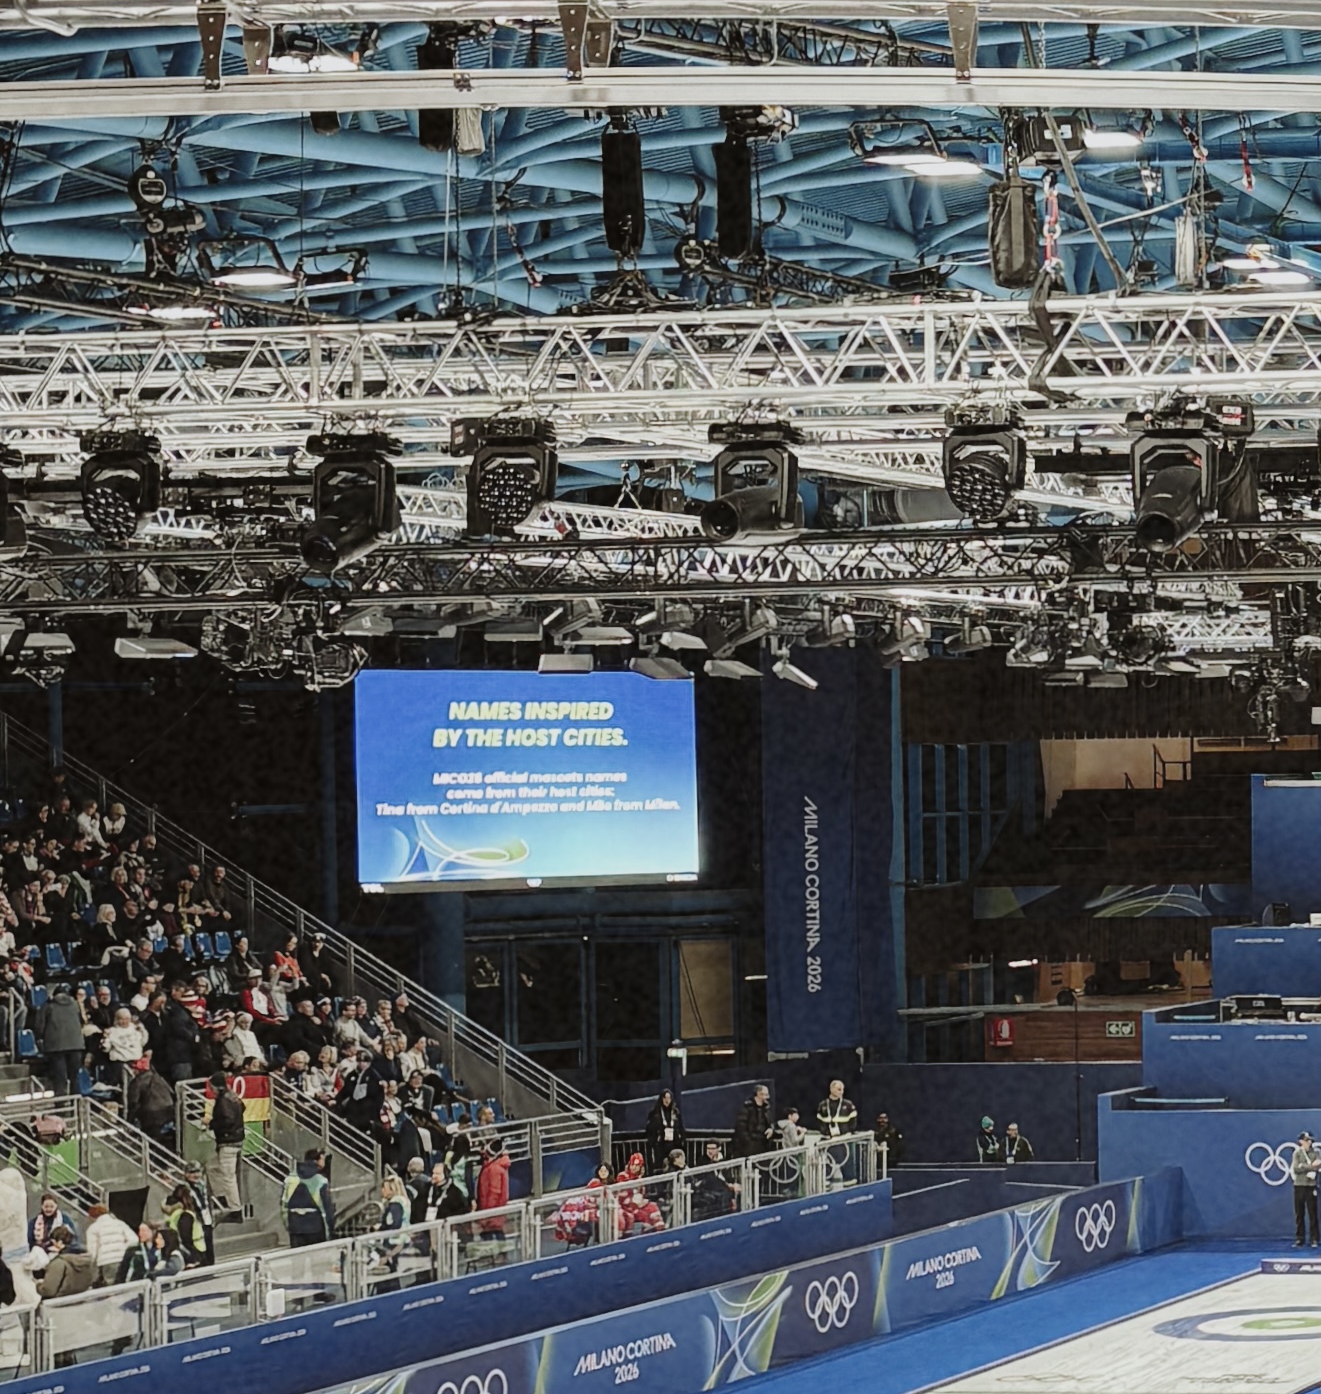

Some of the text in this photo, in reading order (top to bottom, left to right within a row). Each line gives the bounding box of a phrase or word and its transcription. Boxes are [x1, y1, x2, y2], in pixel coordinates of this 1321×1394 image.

[449, 701, 614, 721] NAMES INSPIRED
[432, 727, 629, 748] BY THE HOST CITIES.
[804, 795, 822, 993] MILANO CORTINA 2026
[906, 1245, 983, 1281] MILANO CORTINA
[573, 1331, 677, 1377] MILANO CORTINA
[614, 1360, 640, 1385] 2026
